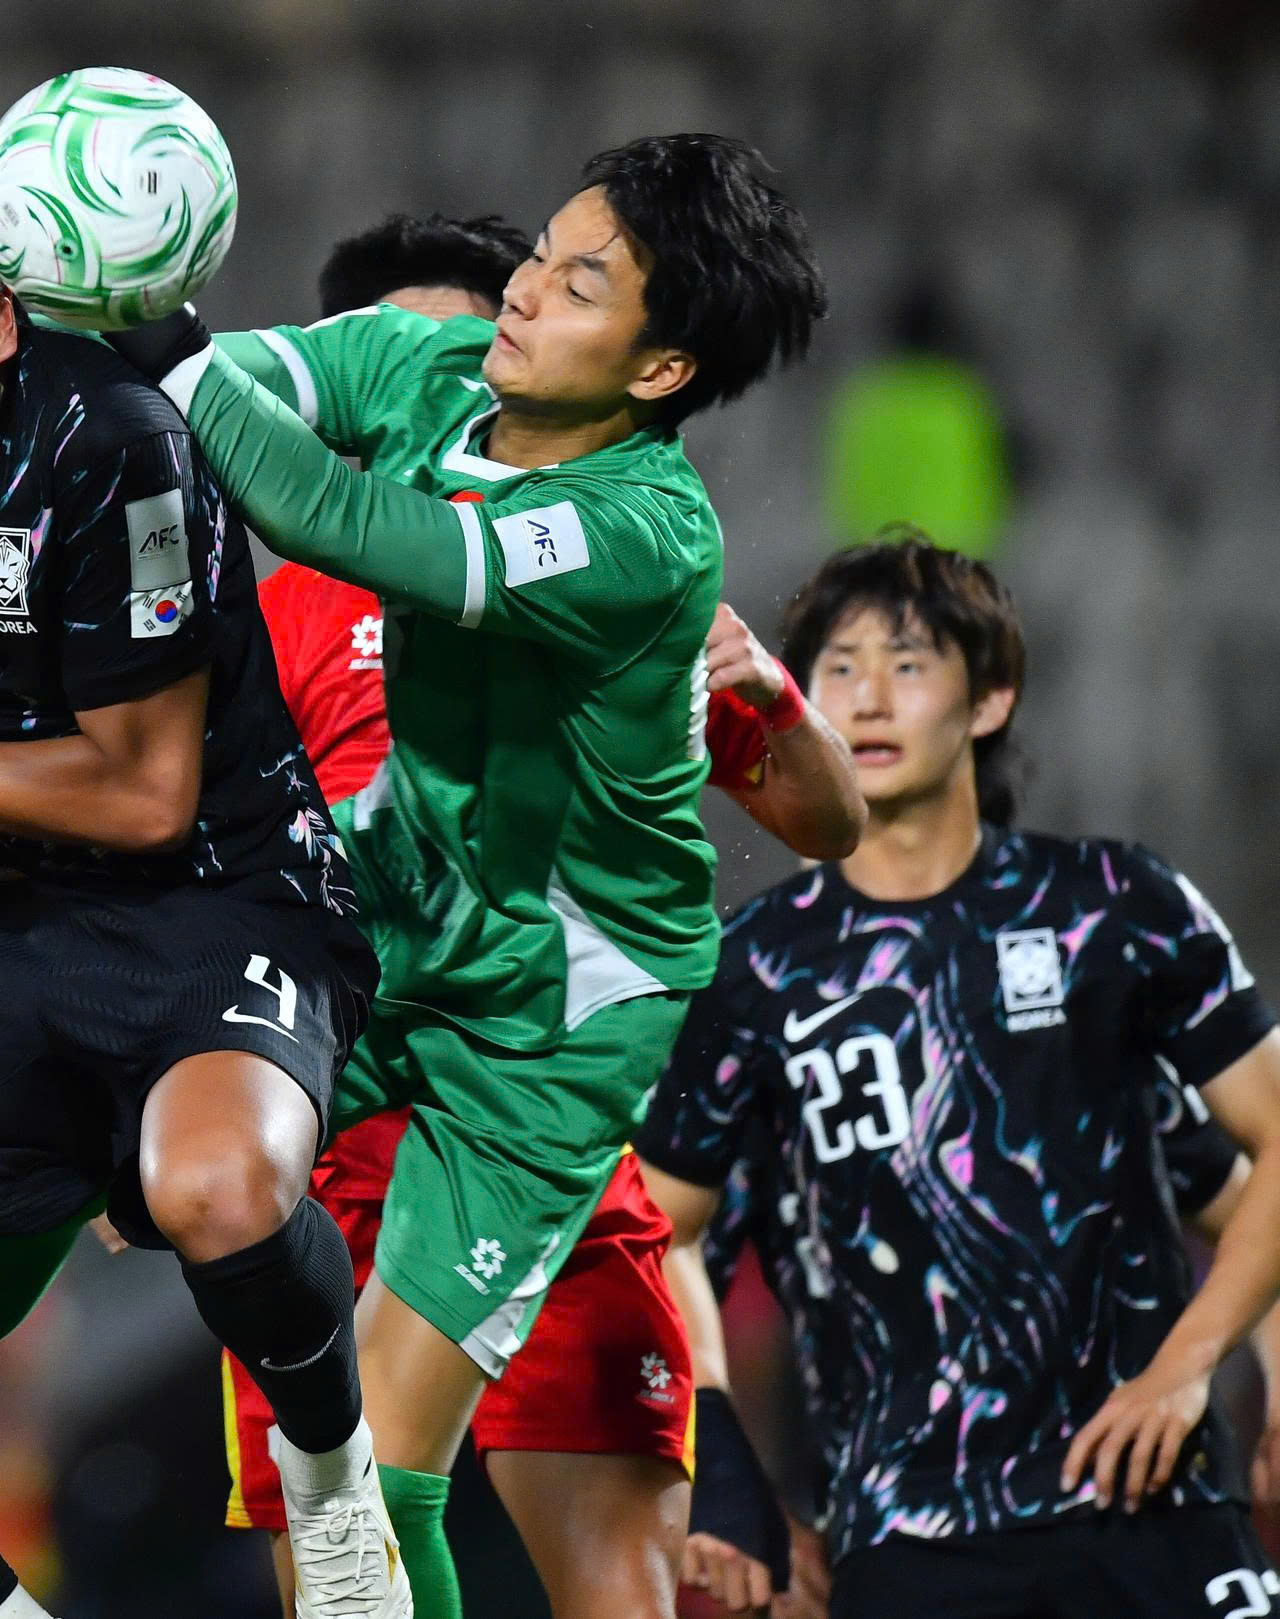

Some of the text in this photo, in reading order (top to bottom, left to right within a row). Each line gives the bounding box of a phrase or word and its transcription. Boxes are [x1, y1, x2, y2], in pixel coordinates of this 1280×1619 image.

[139, 524, 180, 554] AFC
[528, 520, 558, 567] AFC
[245, 954, 297, 1030] 4
[785, 1033, 911, 1163] 23
[1205, 1568, 1280, 1619] 2
